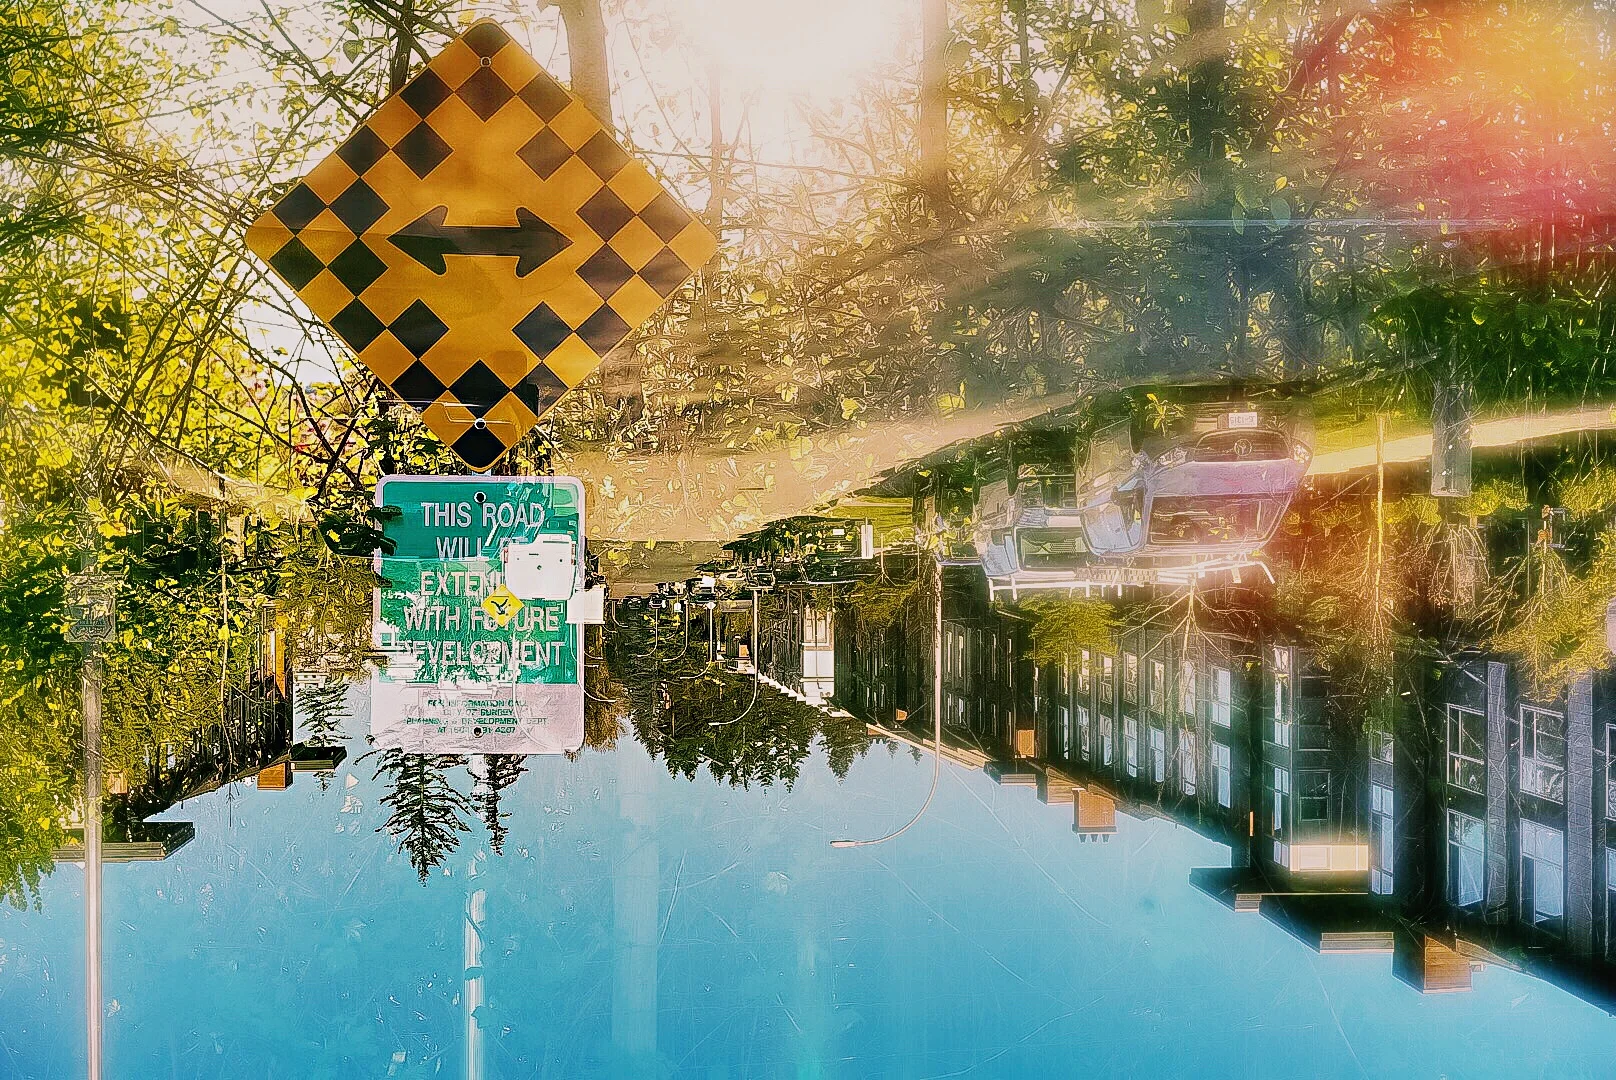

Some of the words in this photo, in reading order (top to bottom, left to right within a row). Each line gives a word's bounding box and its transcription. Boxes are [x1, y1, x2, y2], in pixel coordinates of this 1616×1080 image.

[421, 502, 472, 527] THIS
[482, 502, 545, 527] ROAD
[420, 571, 502, 596] EXTEN
[403, 605, 460, 631] WITH
